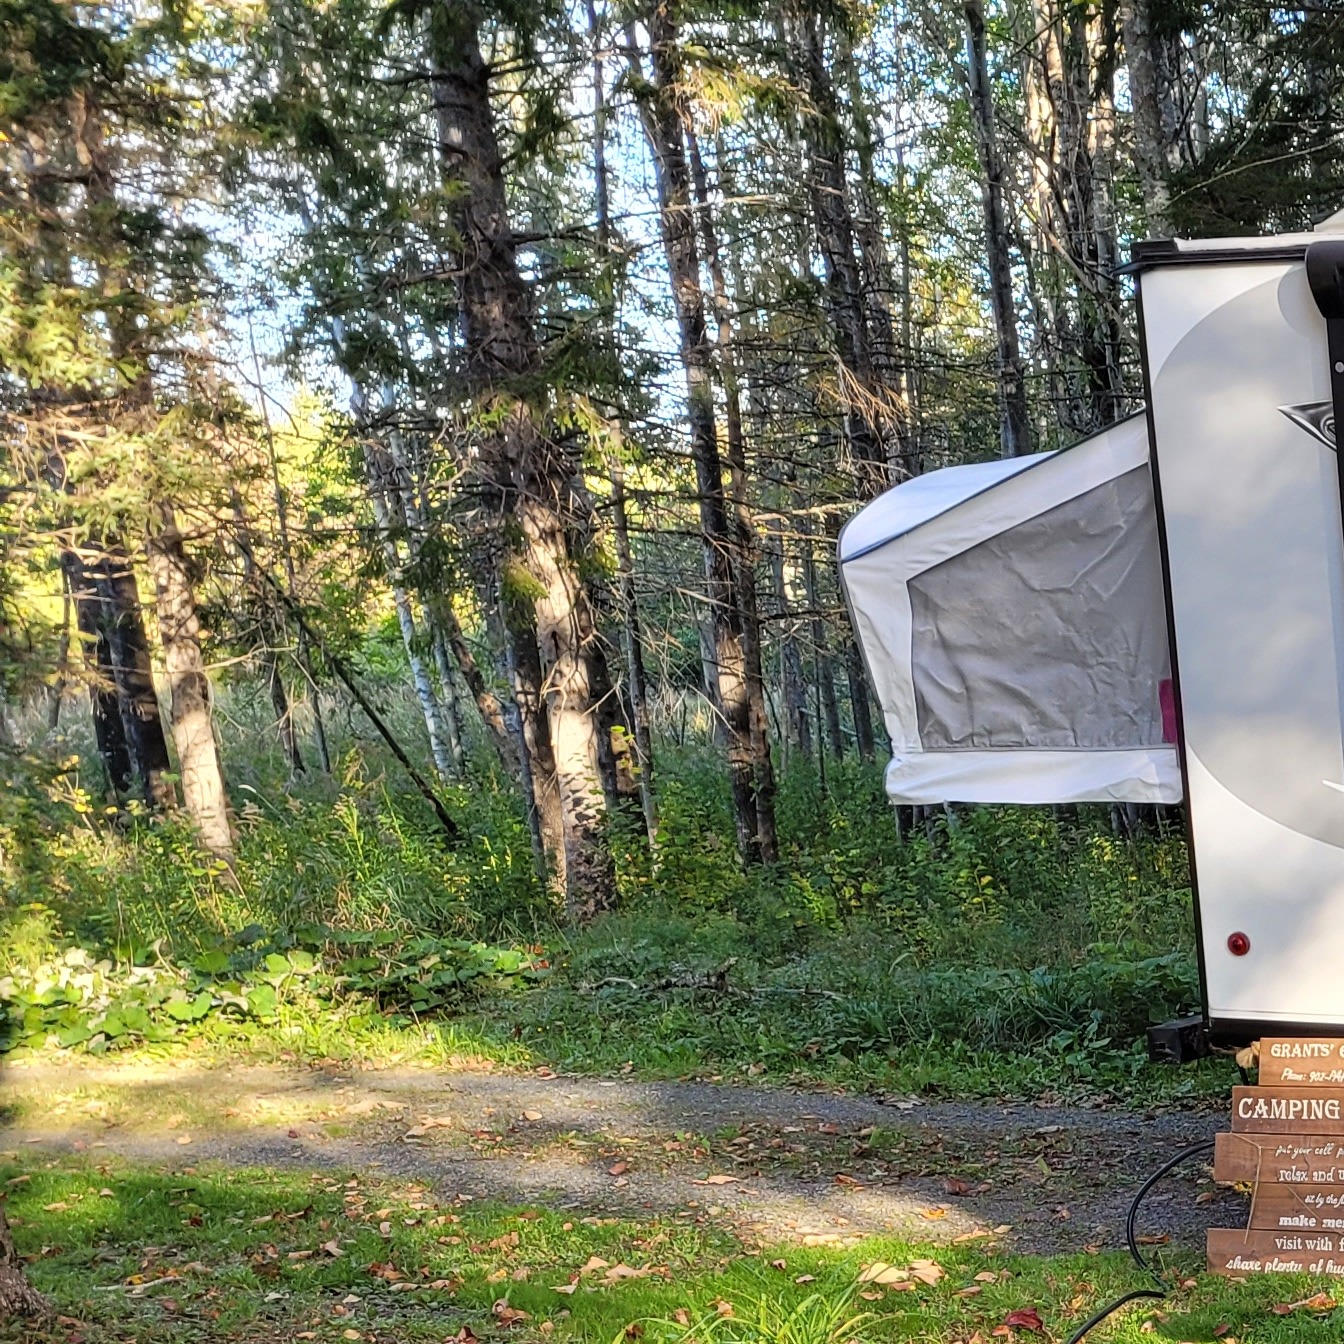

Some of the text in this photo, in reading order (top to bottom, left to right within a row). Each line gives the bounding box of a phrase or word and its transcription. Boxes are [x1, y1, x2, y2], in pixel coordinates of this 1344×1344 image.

[1270, 1043, 1335, 1058] GRANTS'
[1238, 1097, 1340, 1120] CAMPING
[1275, 1144, 1293, 1157] put
[1291, 1147, 1313, 1159] your
[1314, 1142, 1335, 1156] cell
[1278, 1165, 1309, 1181] relax
[1312, 1166, 1336, 1182] and
[1304, 1194, 1316, 1203] sit
[1315, 1193, 1325, 1208] by
[1325, 1193, 1338, 1205] the
[1278, 1214, 1317, 1227] make
[1274, 1236, 1303, 1250] visit
[1304, 1236, 1333, 1251] with
[1225, 1255, 1262, 1271] share
[1308, 1258, 1324, 1276] of
